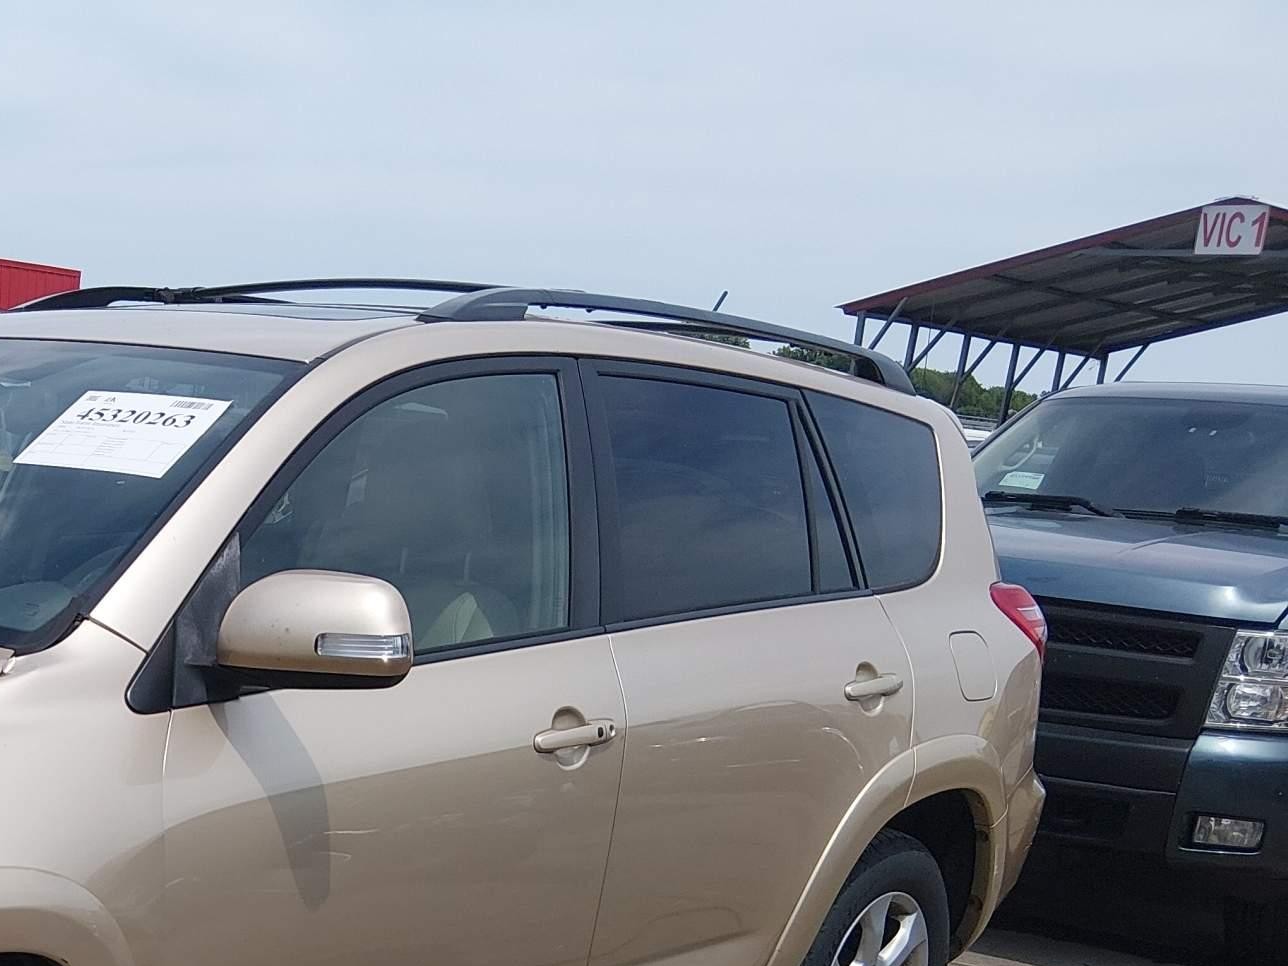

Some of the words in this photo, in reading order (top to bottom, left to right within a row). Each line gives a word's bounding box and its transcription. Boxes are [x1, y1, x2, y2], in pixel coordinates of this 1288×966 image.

[1203, 211, 1246, 249] VIC
[1251, 211, 1266, 248] 1
[76, 407, 196, 429] 45320263
